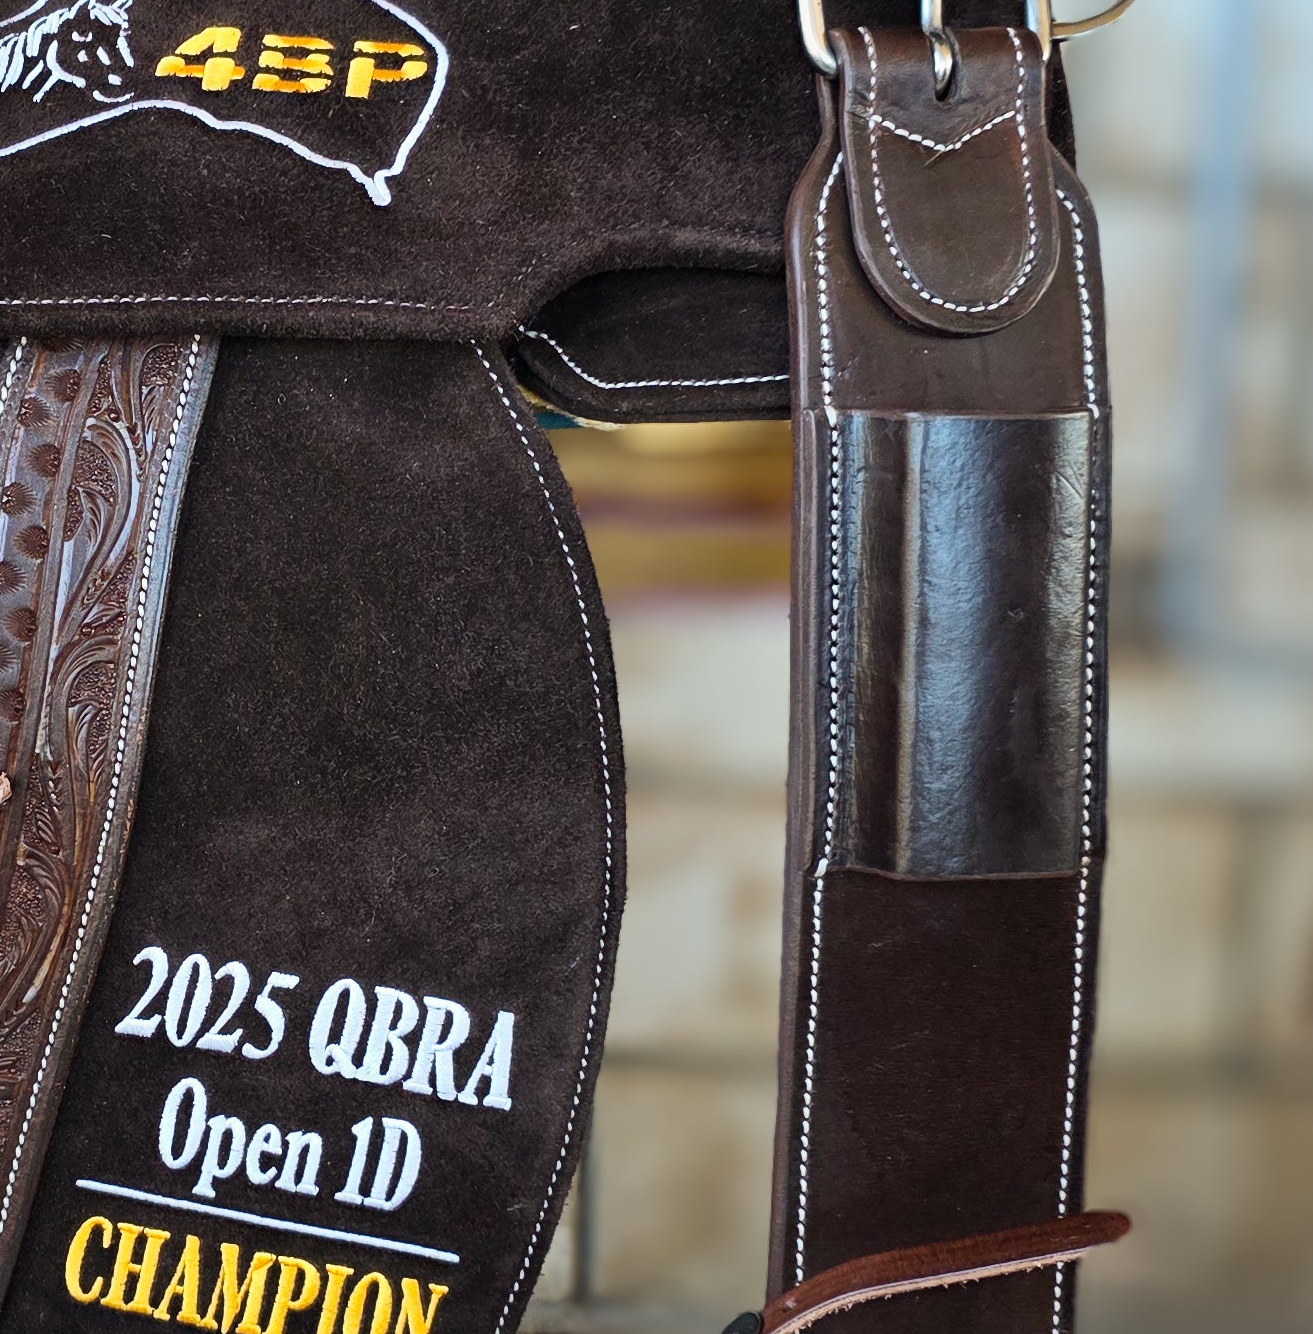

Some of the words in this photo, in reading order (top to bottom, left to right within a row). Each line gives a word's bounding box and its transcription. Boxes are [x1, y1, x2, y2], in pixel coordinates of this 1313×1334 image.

[114, 945, 300, 1060] 2025
[309, 978, 515, 1111] QBRA
[158, 1077, 323, 1197] Open
[334, 1116, 423, 1212] 1D
